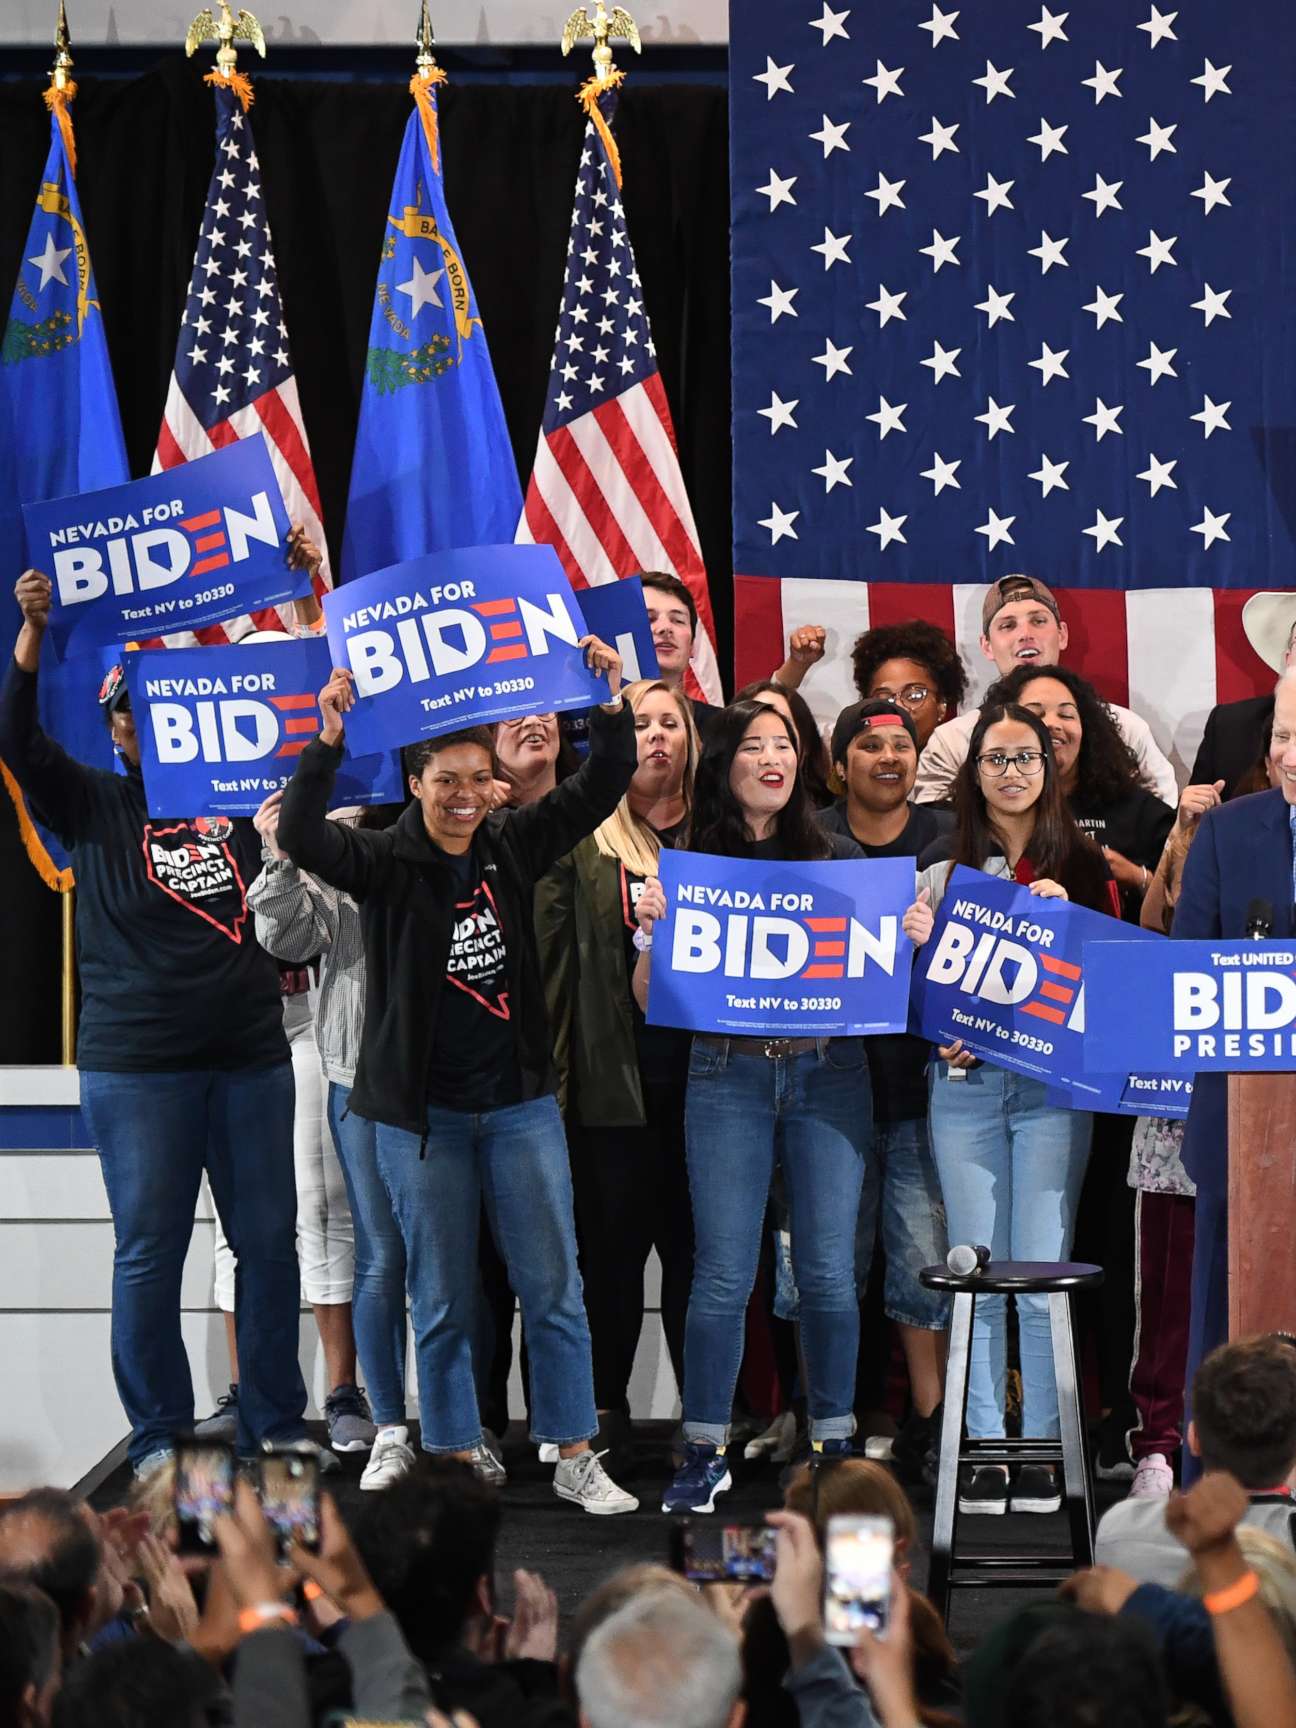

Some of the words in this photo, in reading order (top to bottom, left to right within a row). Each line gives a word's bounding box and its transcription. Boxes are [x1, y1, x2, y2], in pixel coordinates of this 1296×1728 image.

[448, 262, 465, 311] BORN
[50, 514, 138, 547] NEVADA
[143, 499, 184, 526] FOR
[54, 491, 279, 606] BIDEN
[121, 606, 152, 621] Text
[155, 600, 176, 615] NV
[178, 598, 193, 610] to
[195, 583, 234, 605] 30330
[342, 592, 428, 632] NEVADA
[430, 580, 476, 604] FOR
[346, 594, 580, 698] BIDEN
[146, 677, 227, 696] NEVADA
[231, 673, 276, 693] FOR
[420, 696, 452, 712] Text
[454, 687, 475, 702] NV
[478, 685, 492, 697] to
[494, 677, 534, 694] 30330
[150, 693, 319, 763] BIDE
[211, 780, 238, 792] Text
[240, 779, 259, 791] NV
[262, 779, 277, 789] to
[151, 843, 220, 868] BIDEN
[156, 859, 225, 880] PRECINCT
[168, 868, 233, 892] CAPTAIN
[678, 884, 765, 911] NEVADA
[771, 894, 813, 912] FOR
[952, 899, 1013, 934] NEVADA
[1016, 921, 1054, 948] FOR
[447, 945, 506, 972] CAPTAIN
[672, 907, 897, 979] BIDEN
[1211, 952, 1240, 966] Text
[1242, 952, 1293, 965] UNITED
[926, 921, 1085, 1034] BIDE
[726, 995, 756, 1009] Text
[759, 998, 781, 1009] NV
[784, 999, 798, 1010] to
[801, 998, 841, 1010] 30330
[951, 1008, 974, 1028] Text
[974, 1017, 995, 1032] NV
[996, 1025, 1009, 1039] to
[1011, 1030, 1053, 1056] 30330
[1128, 1076, 1158, 1091] Text
[1160, 1078, 1183, 1092] NV
